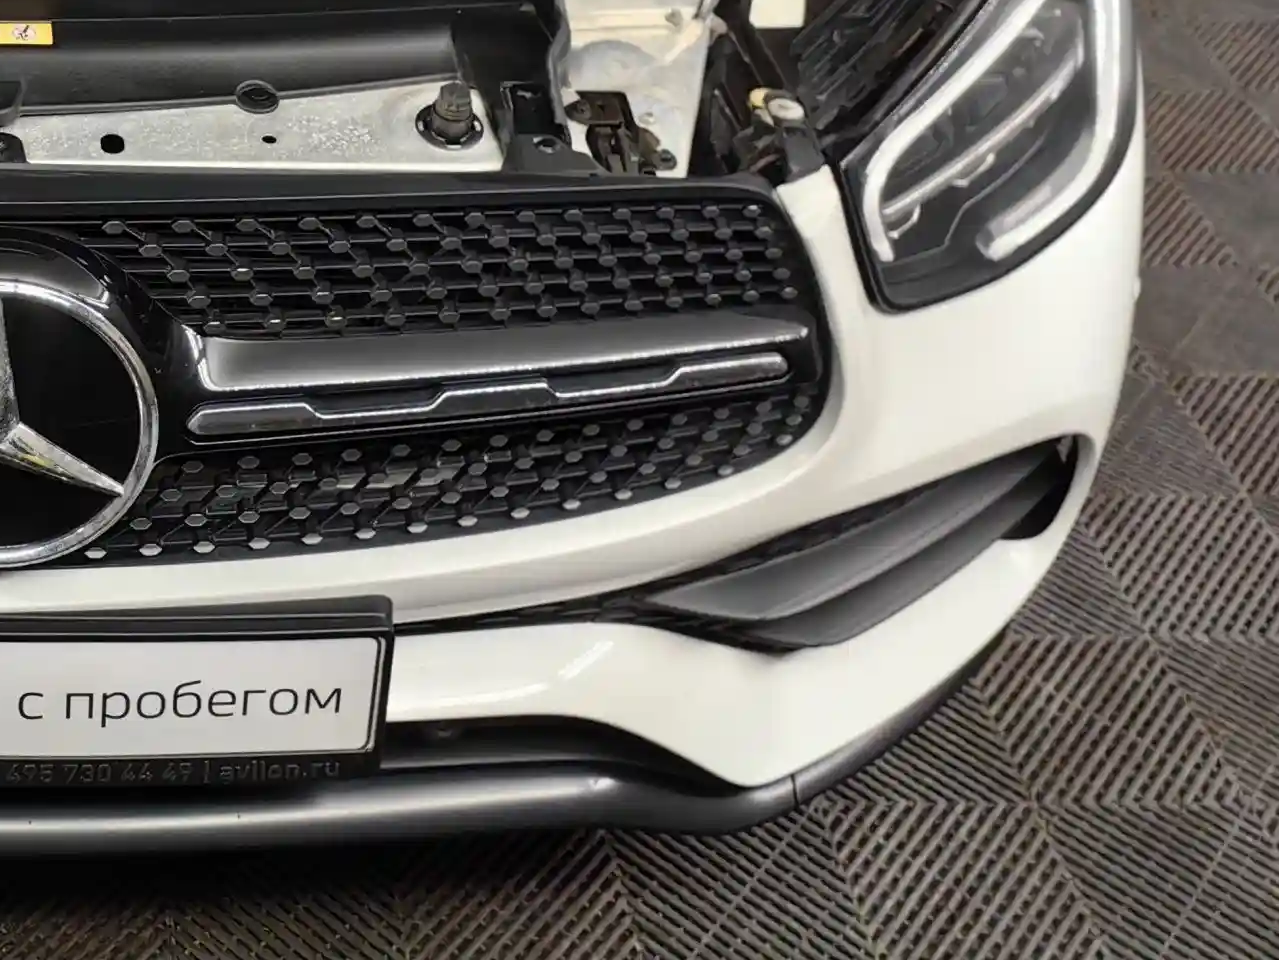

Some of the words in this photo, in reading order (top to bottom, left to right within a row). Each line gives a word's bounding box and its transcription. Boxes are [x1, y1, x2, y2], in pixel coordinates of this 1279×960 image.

[17, 691, 44, 720] с
[65, 680, 342, 728] пробегом
[61, 763, 113, 785] 730
